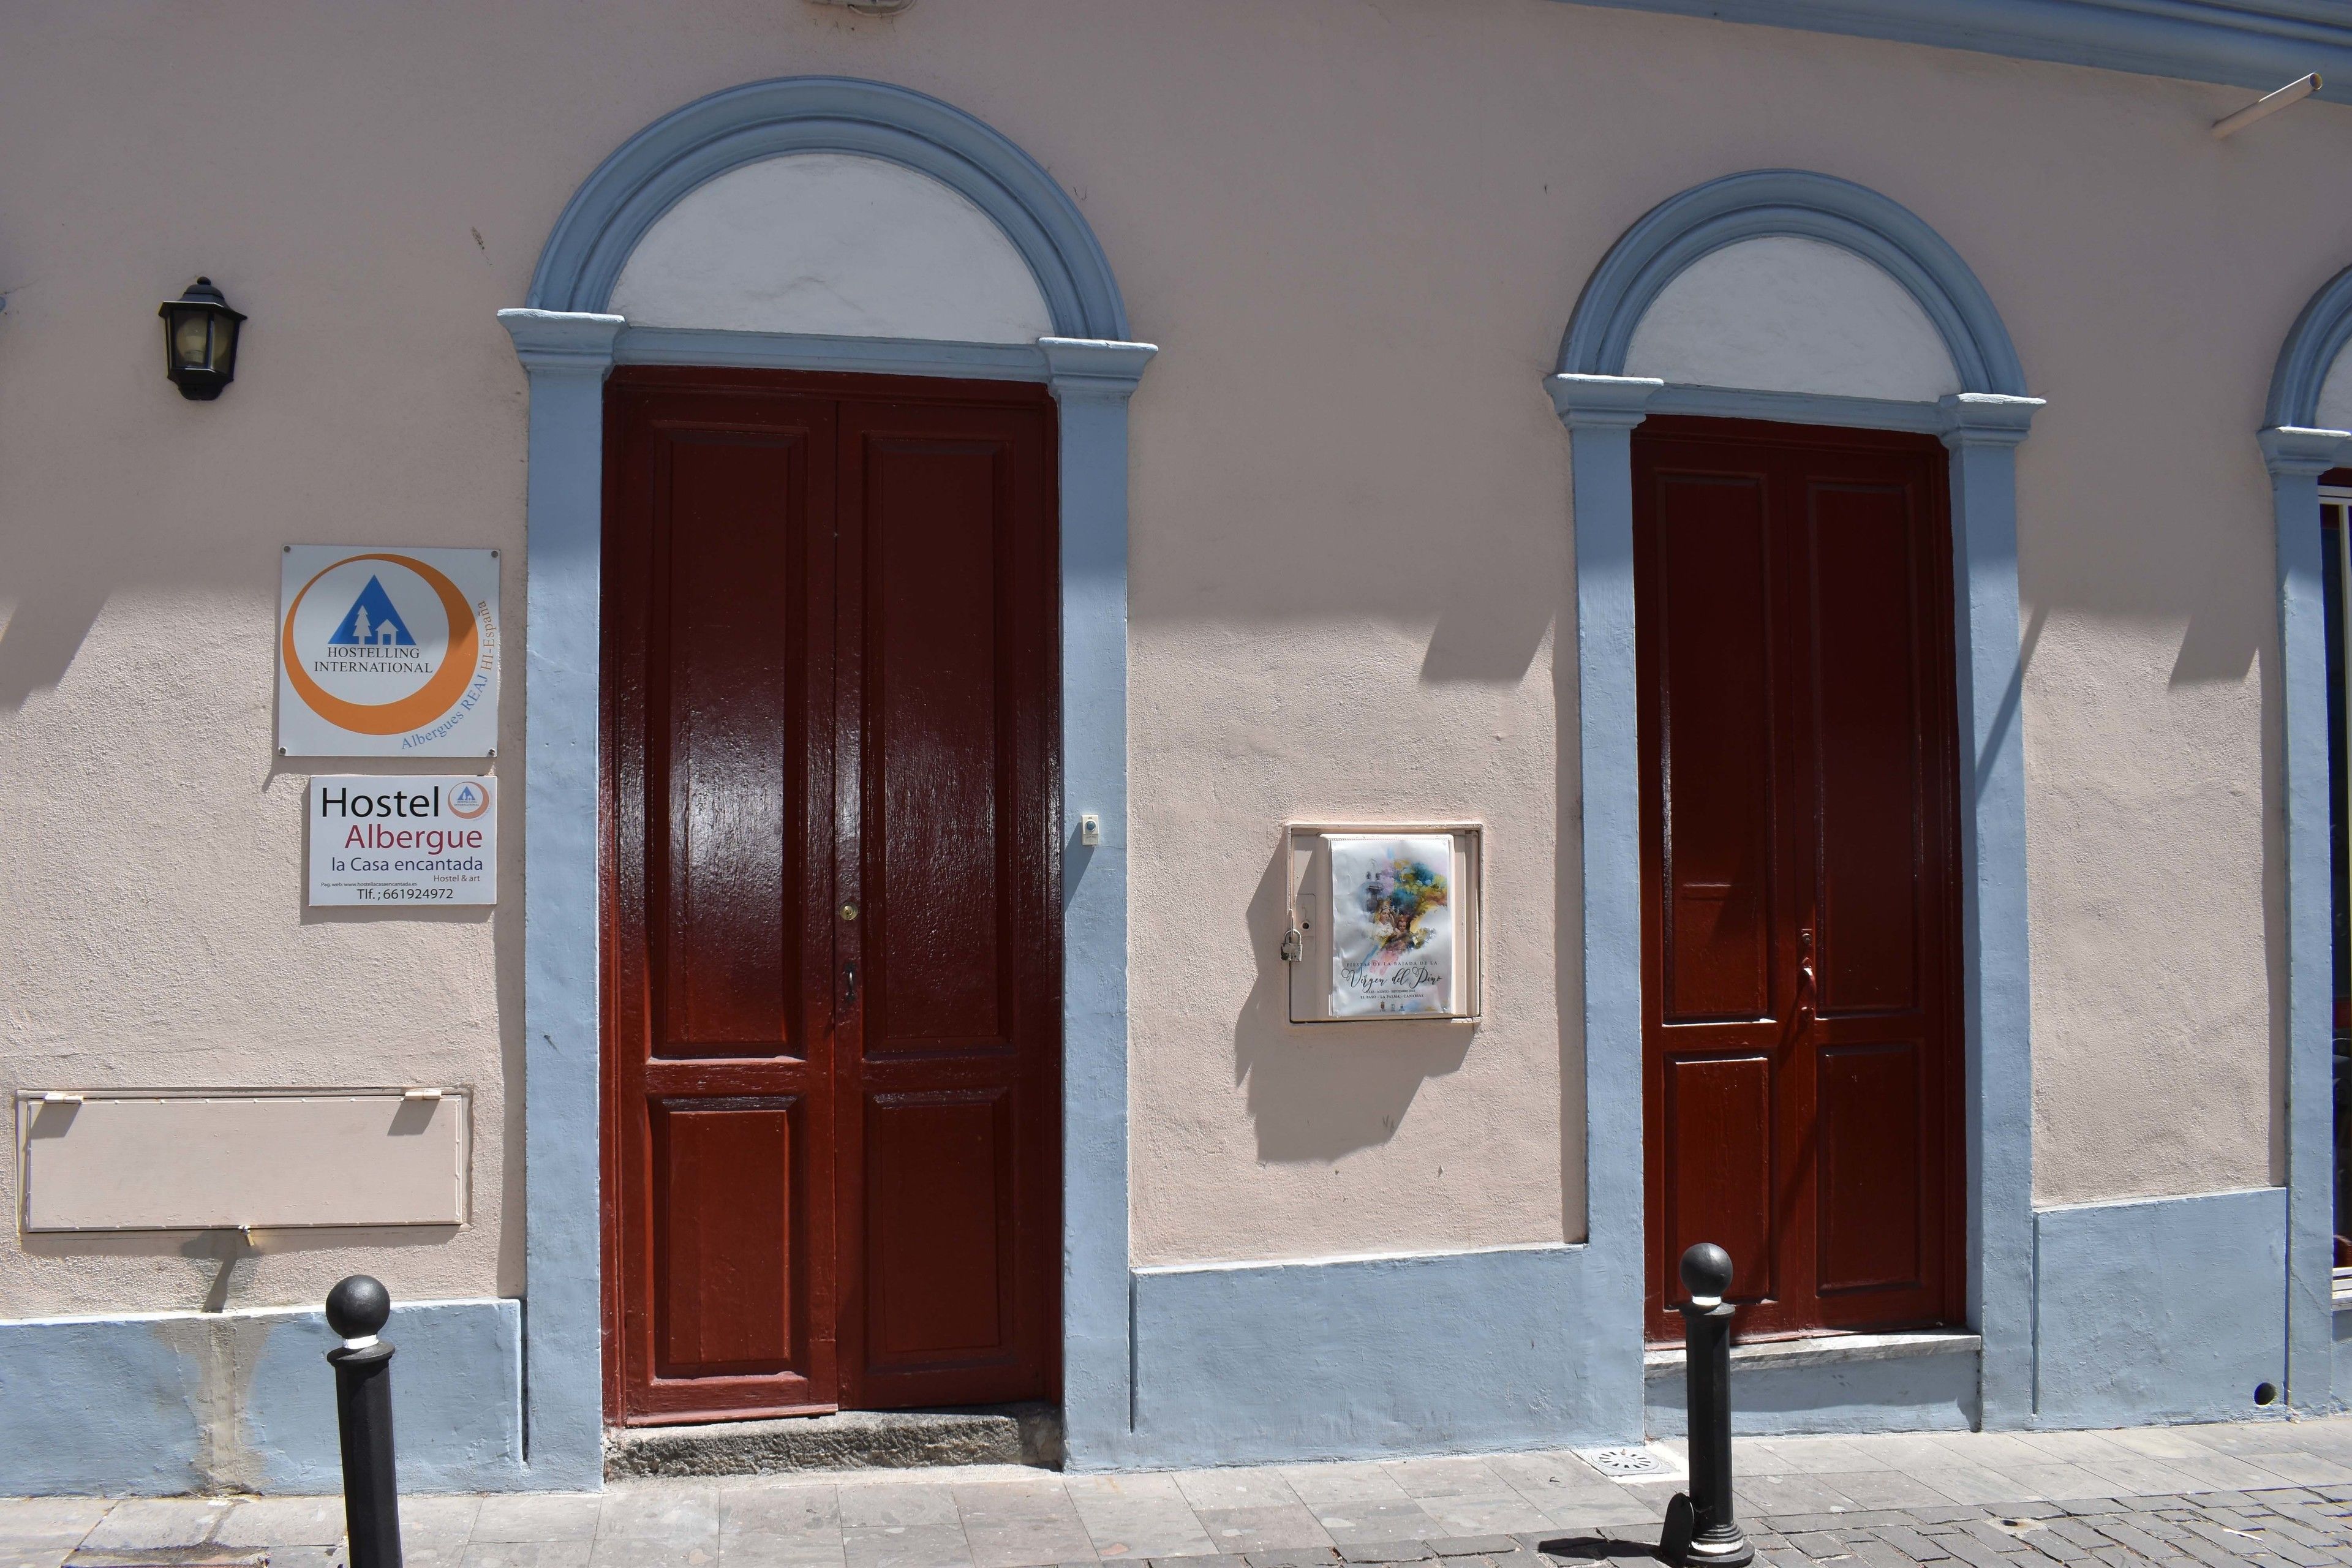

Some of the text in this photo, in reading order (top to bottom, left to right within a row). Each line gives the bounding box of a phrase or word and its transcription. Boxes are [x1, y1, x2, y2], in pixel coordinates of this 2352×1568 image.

[328, 647, 420, 658] HOSTELLING
[314, 661, 433, 673] INTERNATIONAL
[401, 600, 497, 749] Albergues REAJ HI-España
[322, 786, 439, 818] Hostel
[344, 824, 483, 855] Albergue
[332, 856, 483, 871] la Casa encantada
[1341, 966, 1442, 993] Virgen del Pino
